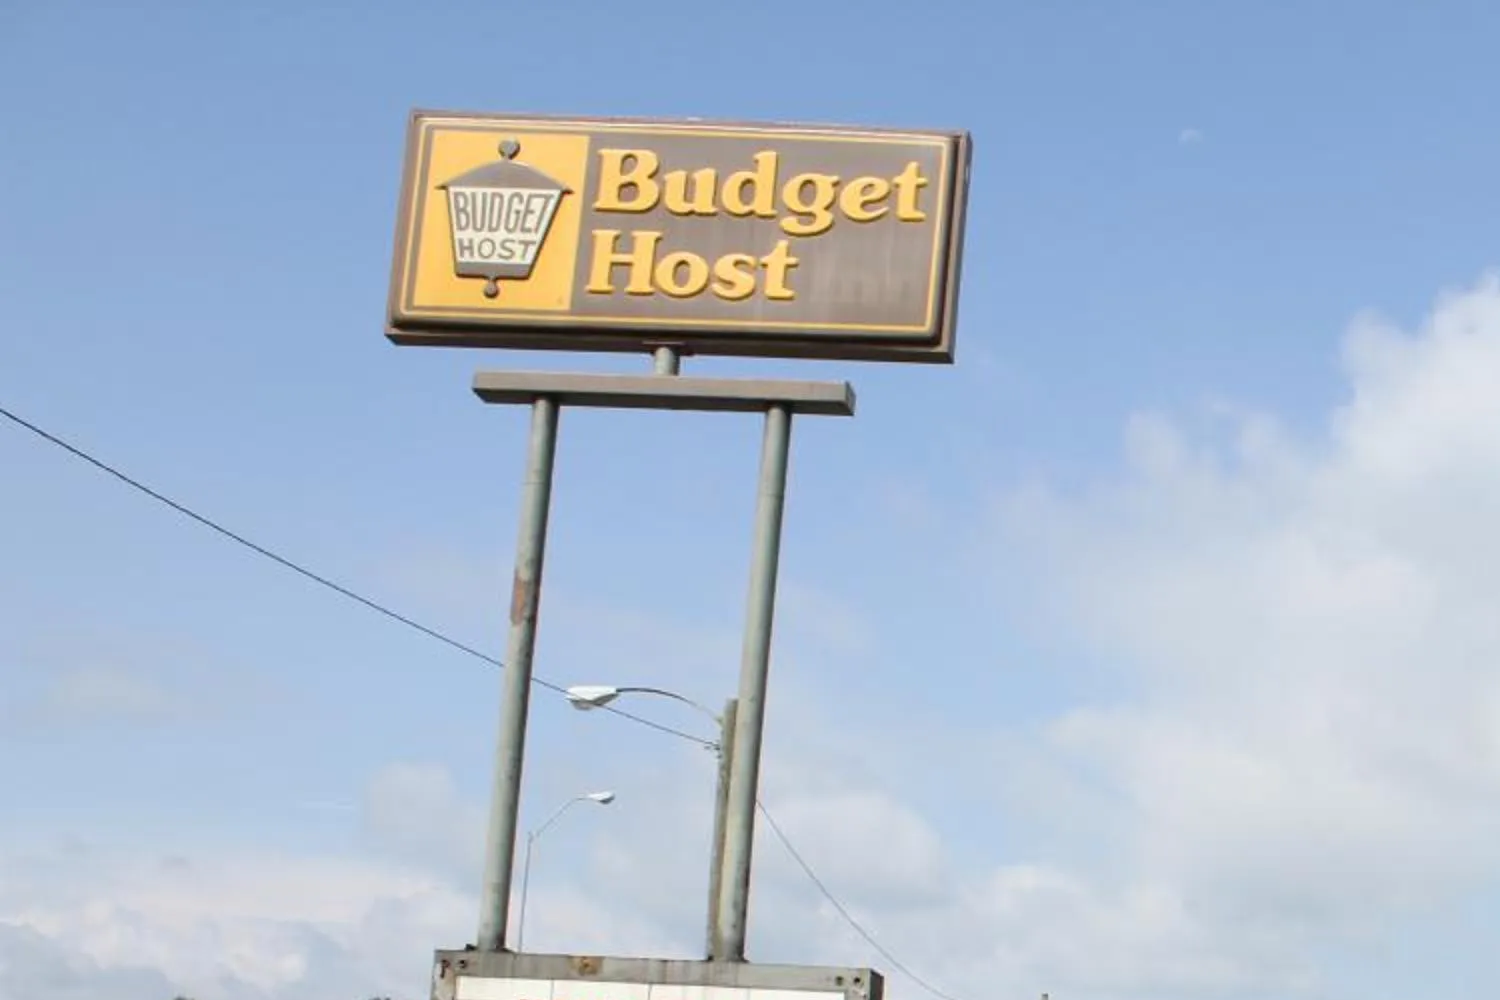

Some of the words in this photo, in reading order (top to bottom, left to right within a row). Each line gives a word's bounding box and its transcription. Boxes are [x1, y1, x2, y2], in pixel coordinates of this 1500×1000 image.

[453, 191, 555, 233] BUDGET
[593, 148, 929, 236] Budget
[457, 238, 537, 260] HOST
[585, 229, 798, 300] Host
